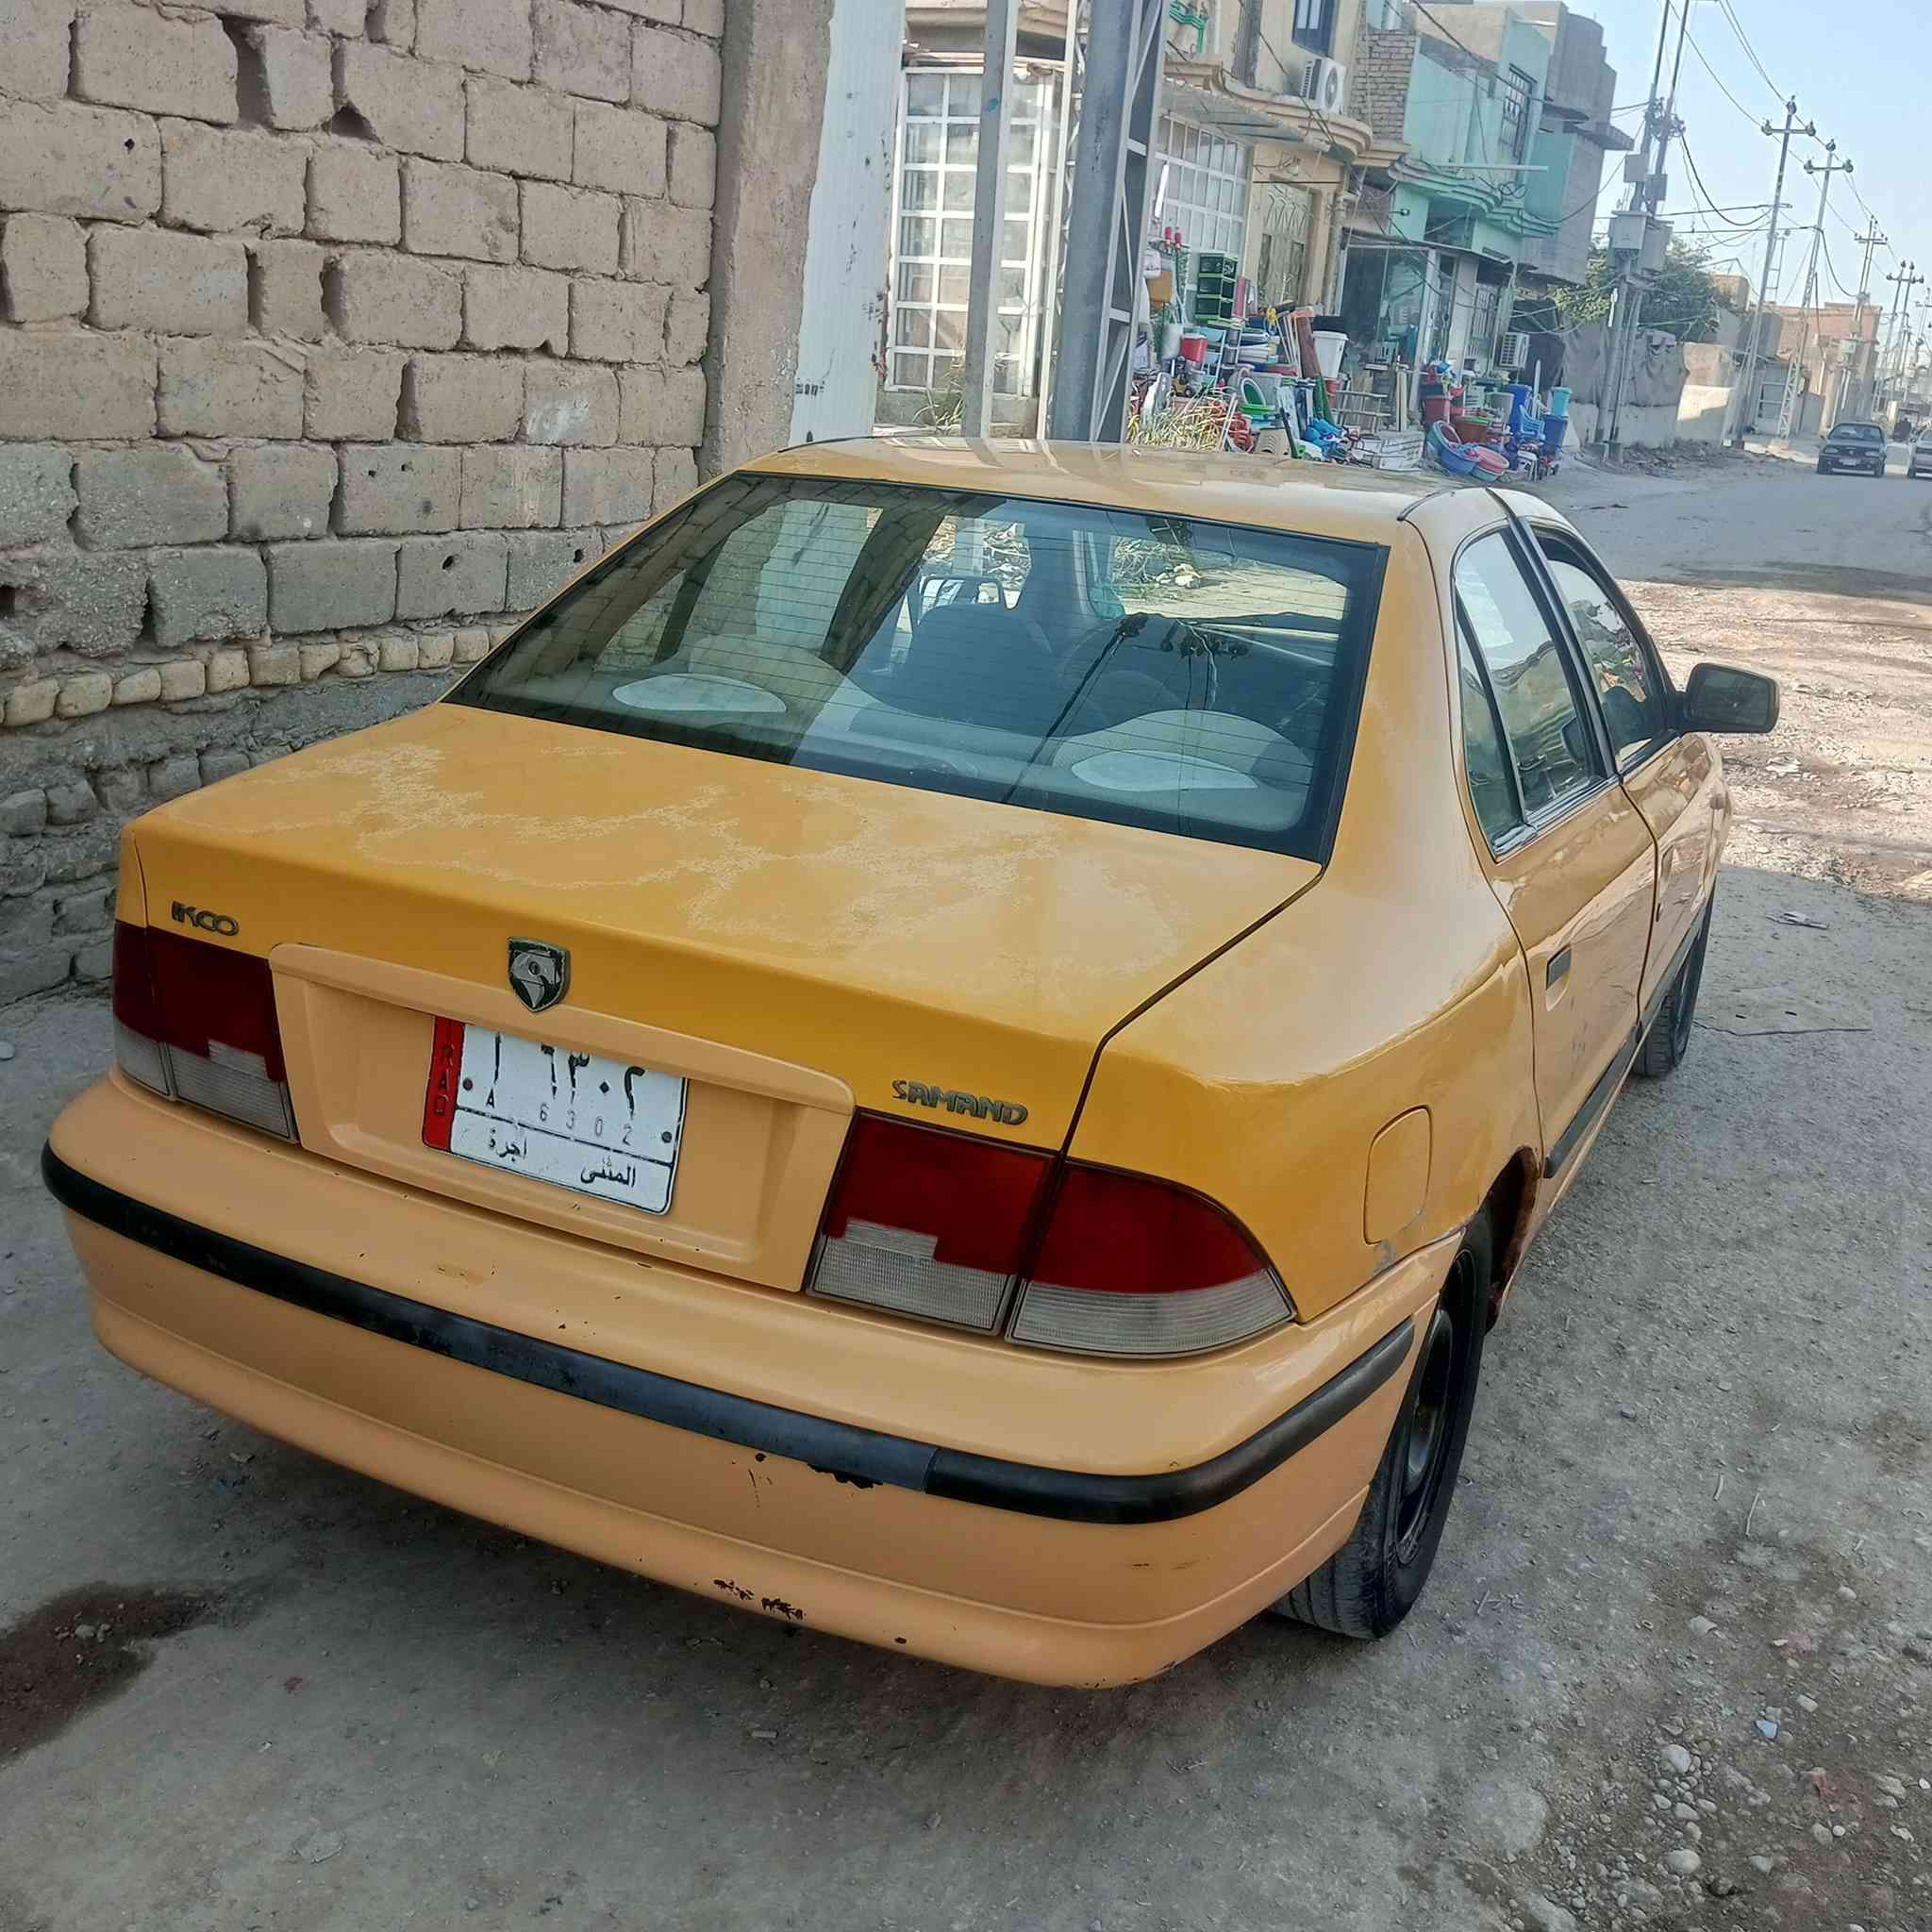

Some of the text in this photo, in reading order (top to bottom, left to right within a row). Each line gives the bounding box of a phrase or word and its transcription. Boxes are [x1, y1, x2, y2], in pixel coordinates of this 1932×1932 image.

[172, 900, 240, 936] IKCO
[485, 1088, 634, 1146] A 6302
[891, 1079, 1029, 1125] SAMAND
